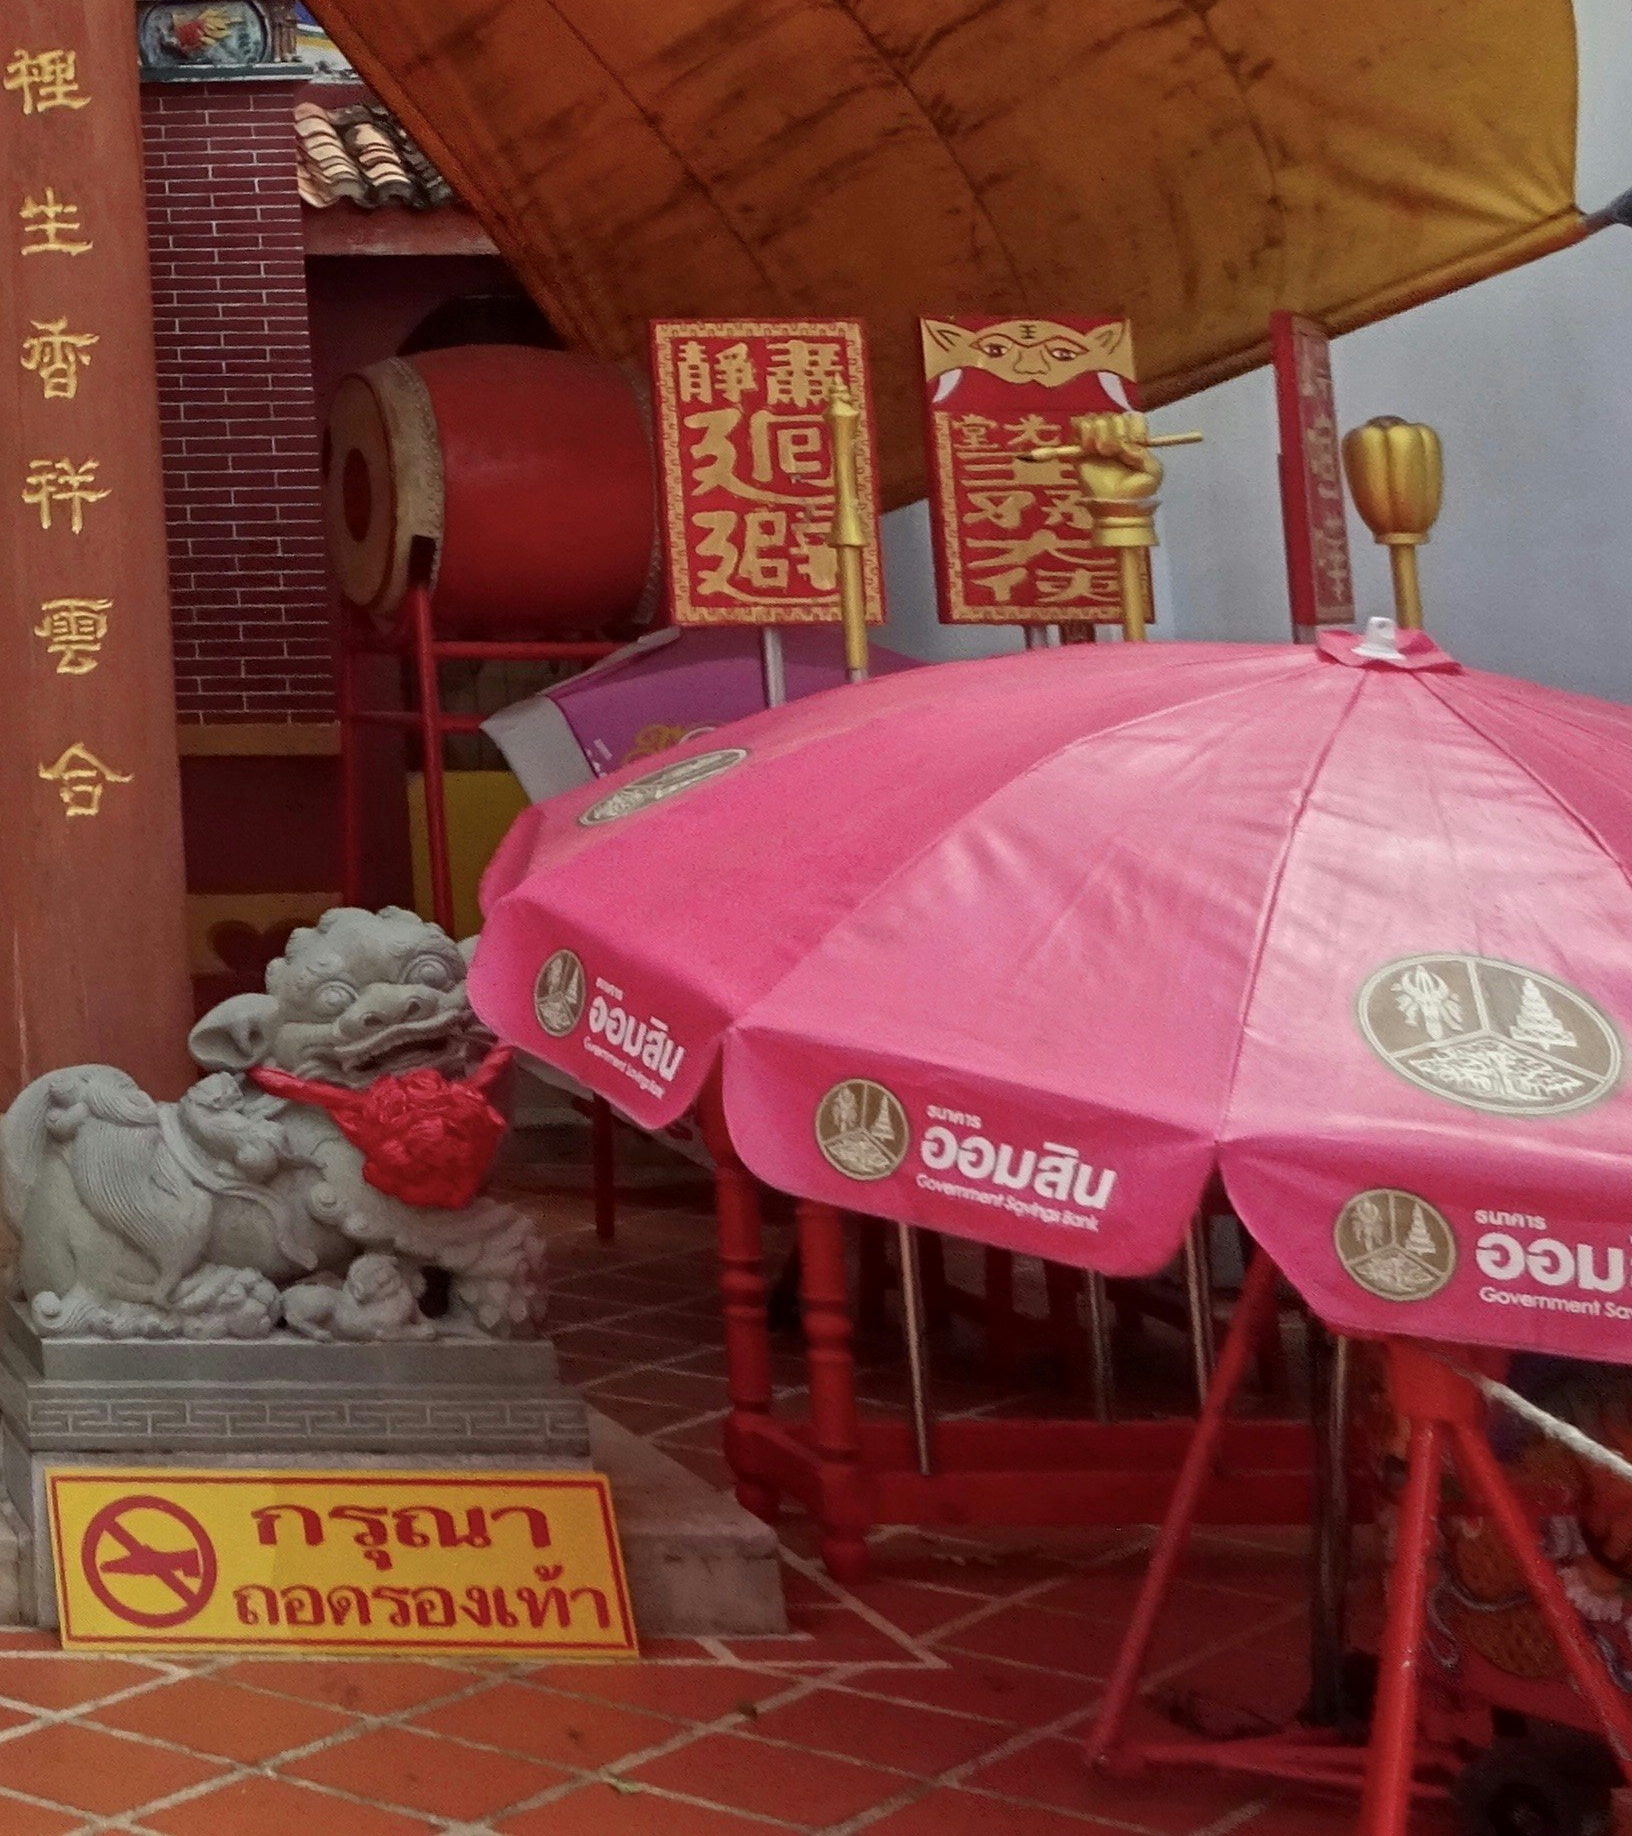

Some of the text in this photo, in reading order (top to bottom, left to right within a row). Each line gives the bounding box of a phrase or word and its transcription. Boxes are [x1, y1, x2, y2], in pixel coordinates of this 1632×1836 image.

[589, 995, 686, 1082] ออมสิน
[926, 1104, 982, 1130] ธนาคาร
[920, 1126, 1118, 1211] ออมสิน
[915, 1172, 1099, 1233] Government Savings Bank
[1473, 1208, 1547, 1231] ธนาคาร
[1475, 1232, 1632, 1294] ออม
[1478, 1285, 1632, 1320] Government Sa
[251, 1503, 553, 1572] กรุณา
[232, 1563, 611, 1632] ถอดรองเท้า
